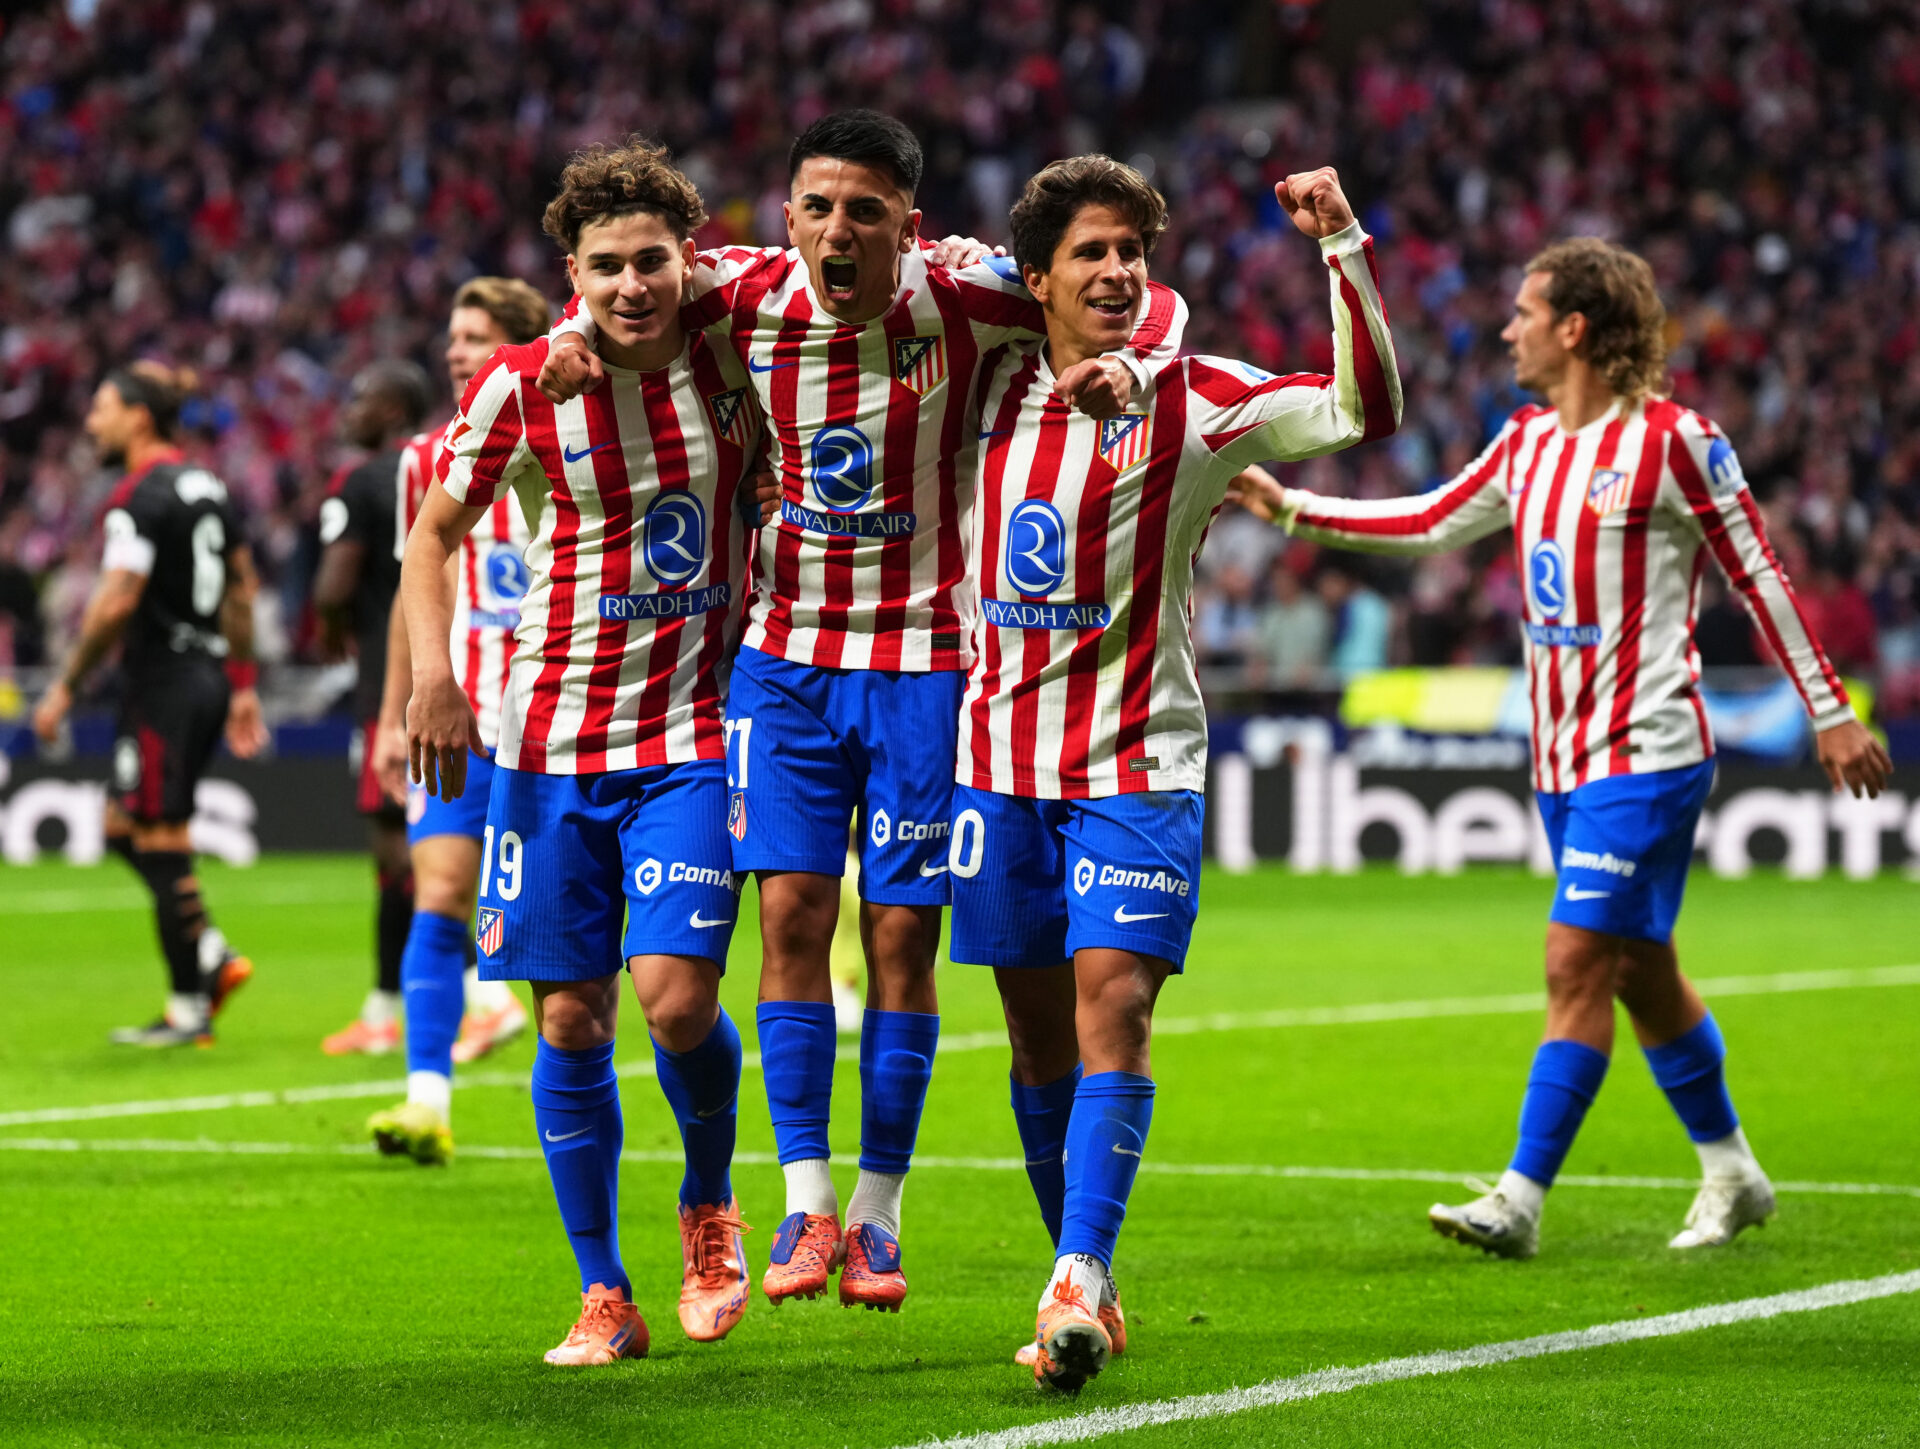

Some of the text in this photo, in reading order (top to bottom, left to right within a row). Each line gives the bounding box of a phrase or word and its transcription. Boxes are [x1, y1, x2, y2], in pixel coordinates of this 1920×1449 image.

[785, 501, 911, 534] RIYADH AIR
[191, 512, 226, 617] 6
[605, 585, 727, 617] RIYADH AIR
[984, 600, 1106, 627] RIYADH AIR
[897, 820, 951, 841] Com
[480, 824, 523, 901] 19
[1098, 865, 1191, 897] ComAve
